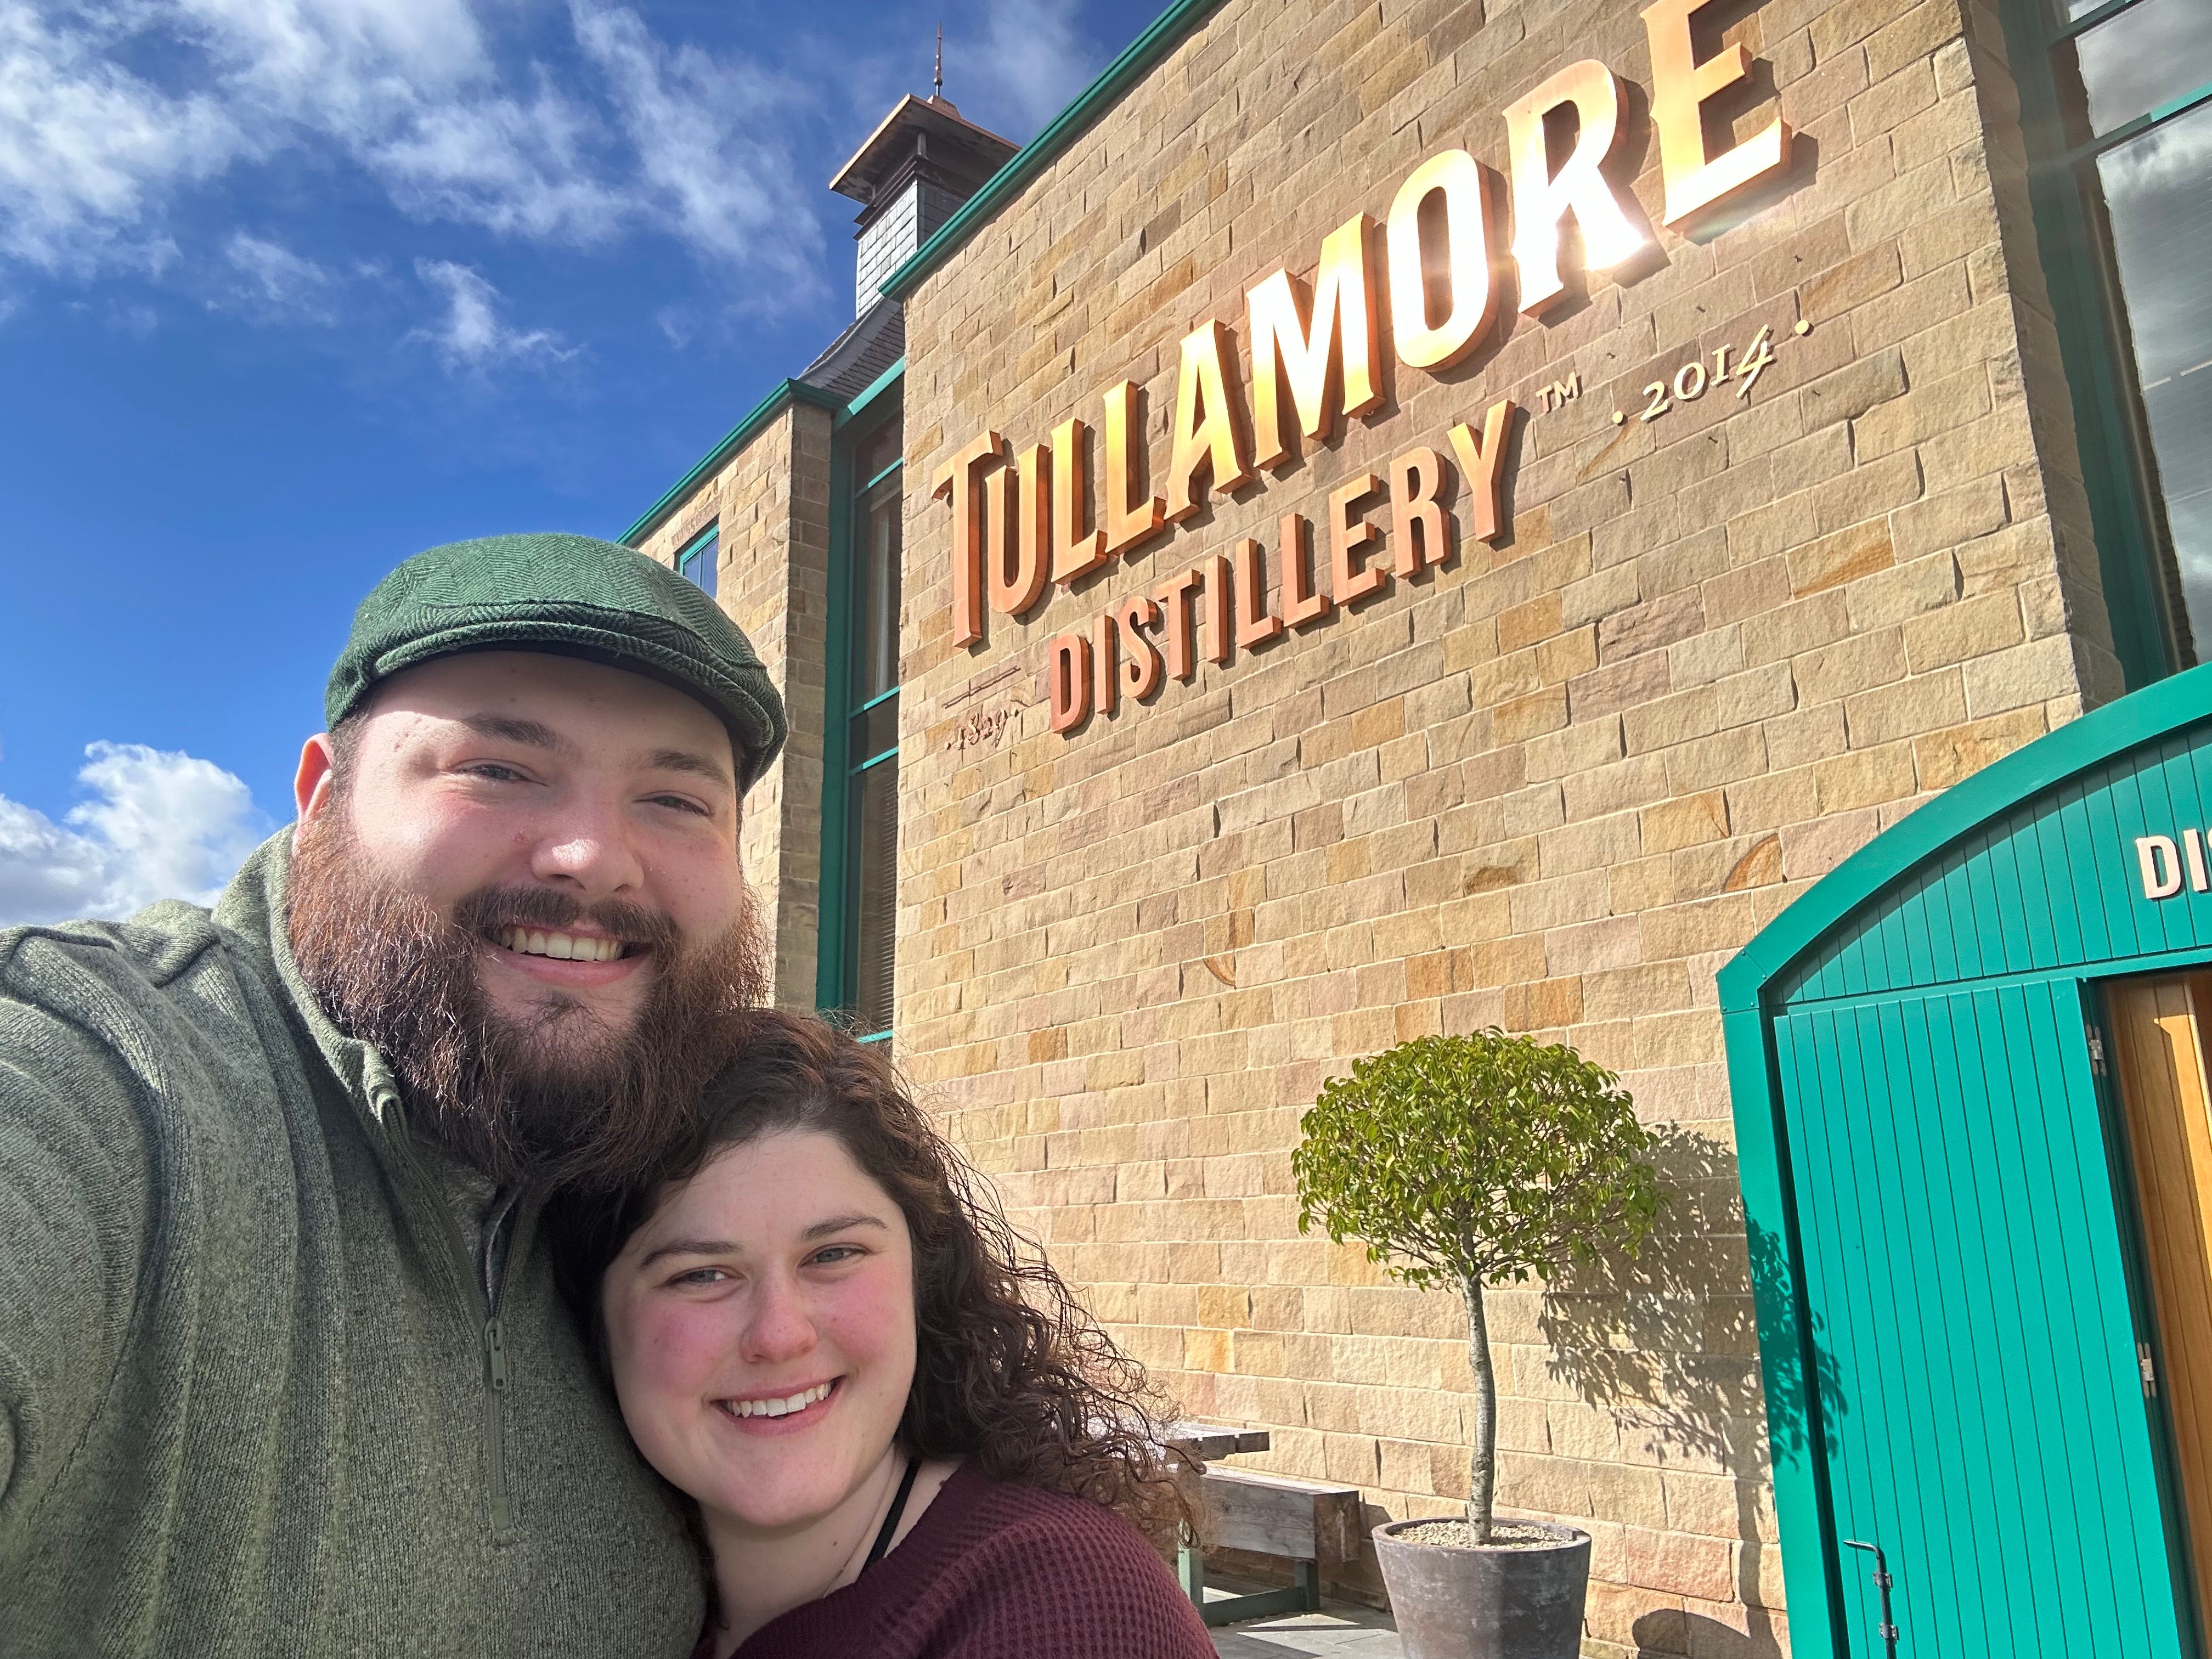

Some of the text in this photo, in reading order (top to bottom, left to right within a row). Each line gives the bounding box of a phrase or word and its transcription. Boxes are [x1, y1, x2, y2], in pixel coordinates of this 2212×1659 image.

[930, 0, 1793, 648] TULLAMORE
[1050, 399, 1516, 734] DISTILLERY
[2135, 827, 2212, 900] DI
